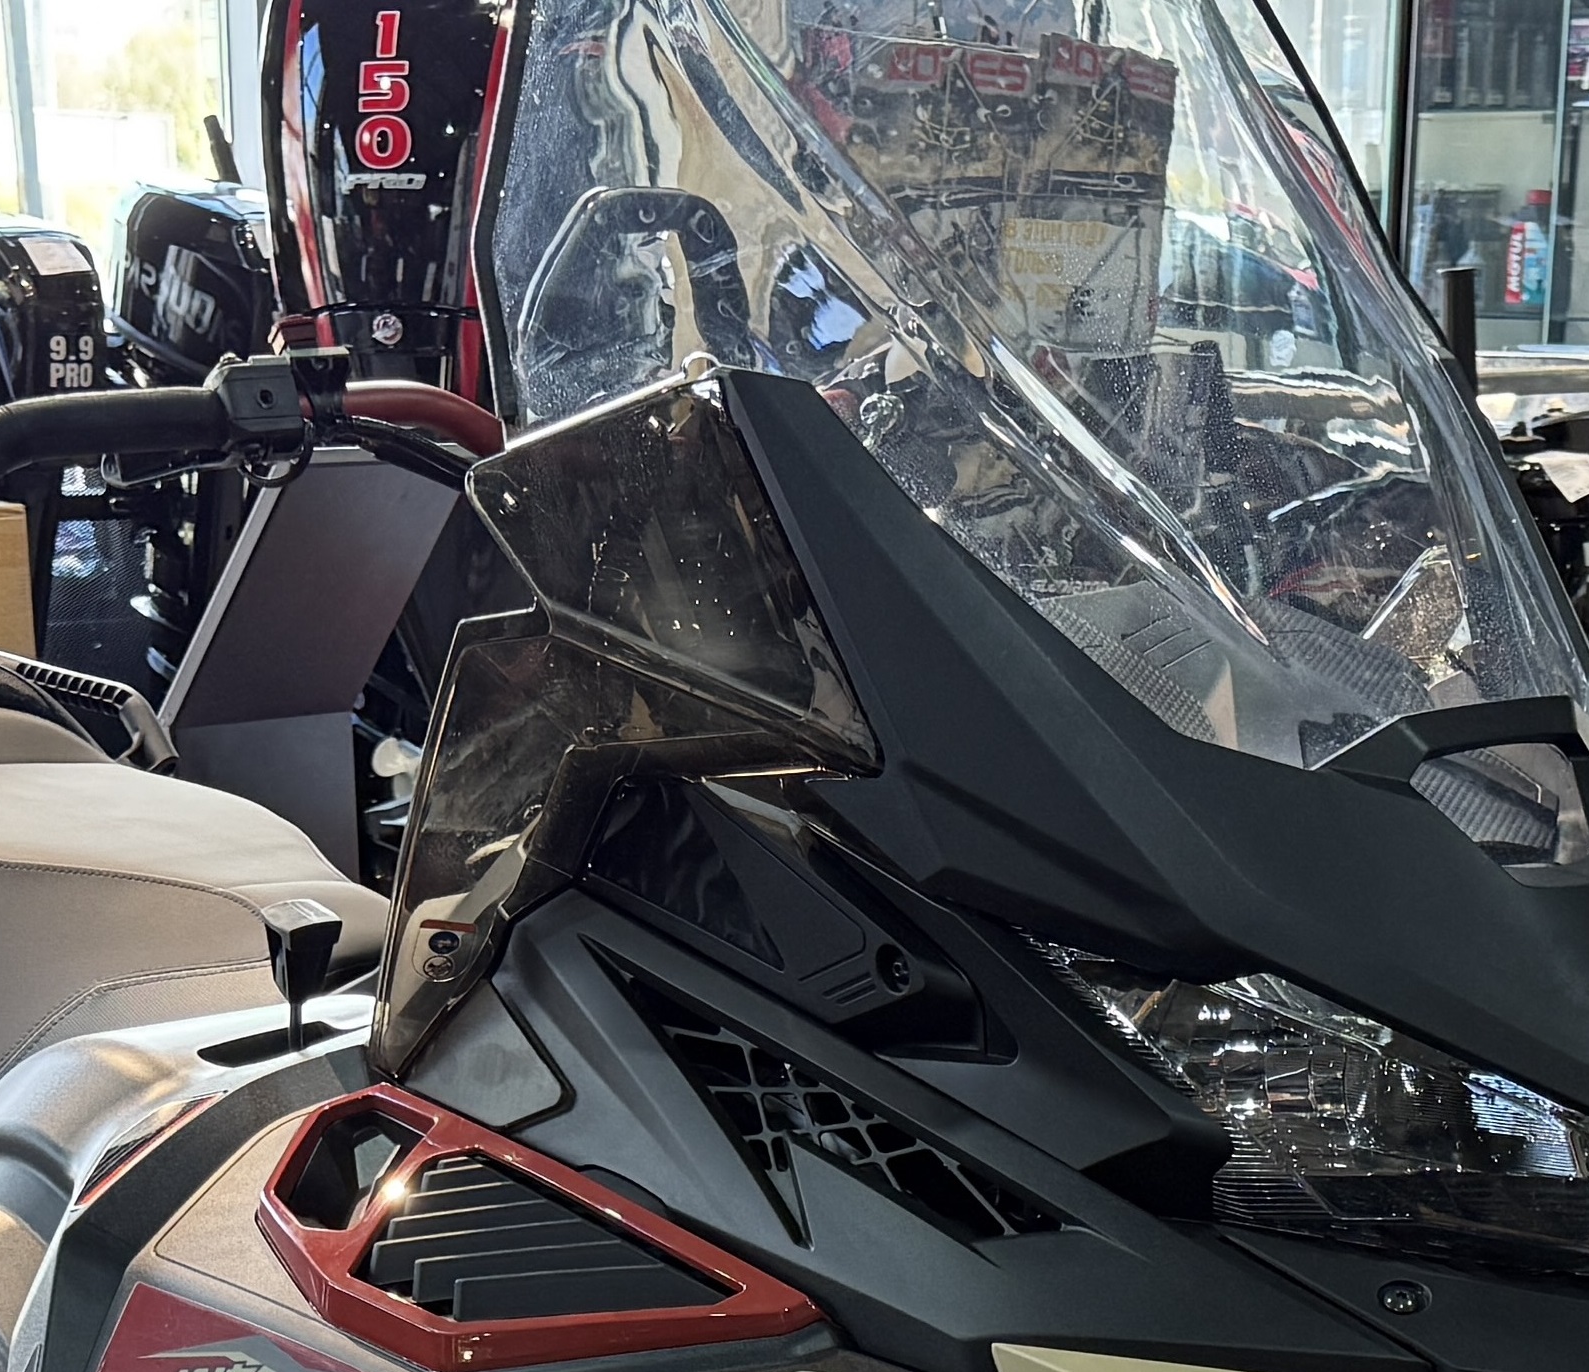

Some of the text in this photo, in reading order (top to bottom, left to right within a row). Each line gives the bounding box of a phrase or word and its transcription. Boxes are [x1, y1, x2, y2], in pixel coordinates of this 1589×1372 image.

[355, 10, 412, 169] 150
[50, 335, 94, 361] 9.9
[50, 363, 93, 388] PRO
